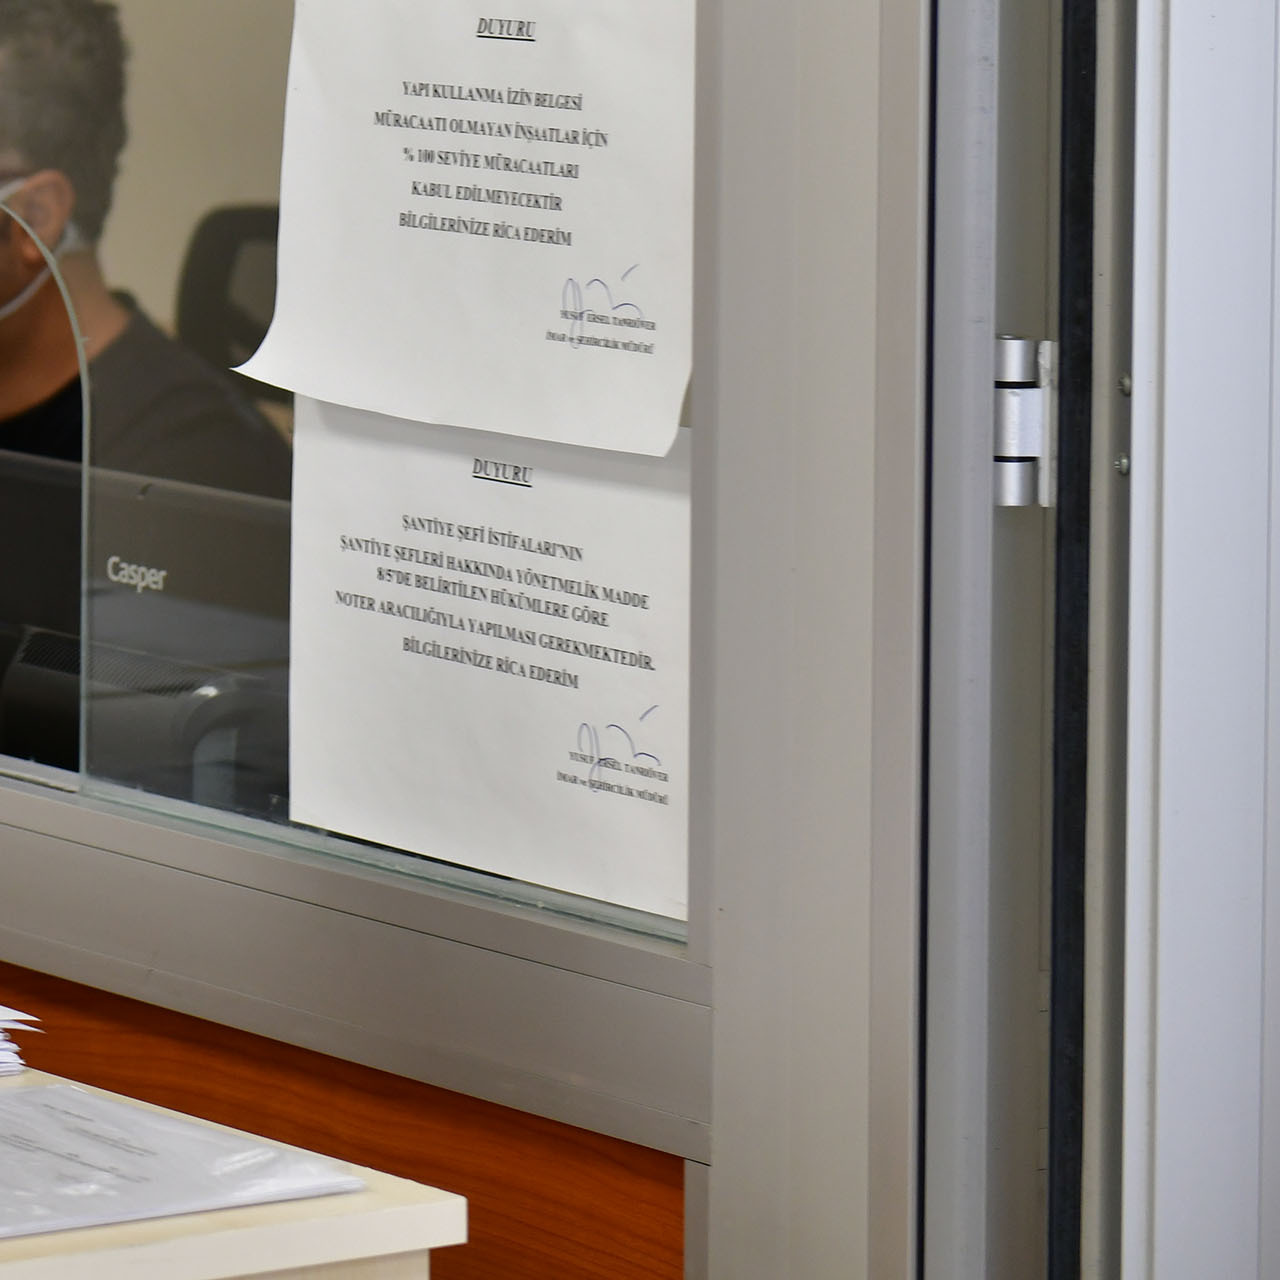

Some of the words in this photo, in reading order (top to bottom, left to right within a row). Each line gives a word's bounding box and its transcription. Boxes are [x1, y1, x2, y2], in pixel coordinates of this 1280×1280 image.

[476, 17, 537, 39] DUYURU
[402, 81, 432, 98] YAPI
[433, 83, 504, 104] KULLANMA
[506, 87, 533, 106] İZİN
[534, 92, 583, 111] BELGESİ
[374, 109, 447, 132] MÜRACAATI
[449, 118, 514, 139] OLMAYAN
[514, 122, 580, 145] İNŞAATLAR
[581, 127, 609, 149] İÇİN
[403, 147, 414, 162] %
[417, 148, 436, 164] 100
[436, 149, 481, 169] SEVİYE
[482, 153, 580, 179] MÜRACAATLARI
[411, 180, 452, 198] KABUL
[455, 184, 563, 211] EDİLMEYECEKTİR
[399, 210, 491, 237] BİLGİLERİNİZE
[492, 221, 521, 240] RİCA
[523, 226, 572, 246] EDERİM
[472, 458, 534, 484] DUYURU
[402, 514, 454, 537] ŞANTİYE
[457, 524, 485, 543] ŞEFİ
[106, 555, 169, 593] Casper
[340, 534, 391, 557] ŞANTİYE
[393, 545, 444, 568] ŞEFLERİ
[446, 555, 514, 582] HAKKINDA
[516, 568, 600, 601] YÖNETMELİK
[601, 586, 650, 609] MADDE
[414, 574, 488, 601] BELİRTİLEN
[490, 588, 570, 619] HÜKÜMLERE
[571, 605, 609, 627] GÖRE
[335, 590, 376, 612] NOTER
[378, 601, 466, 631] ARACILIĞIYLA
[468, 618, 537, 646] YAPILMASI
[539, 633, 656, 671] GEREKMEKTEDİR.
[402, 635, 494, 670] BİLGİLERİNİZE
[496, 657, 526, 677] RİCA
[529, 665, 579, 689] EDERİM
